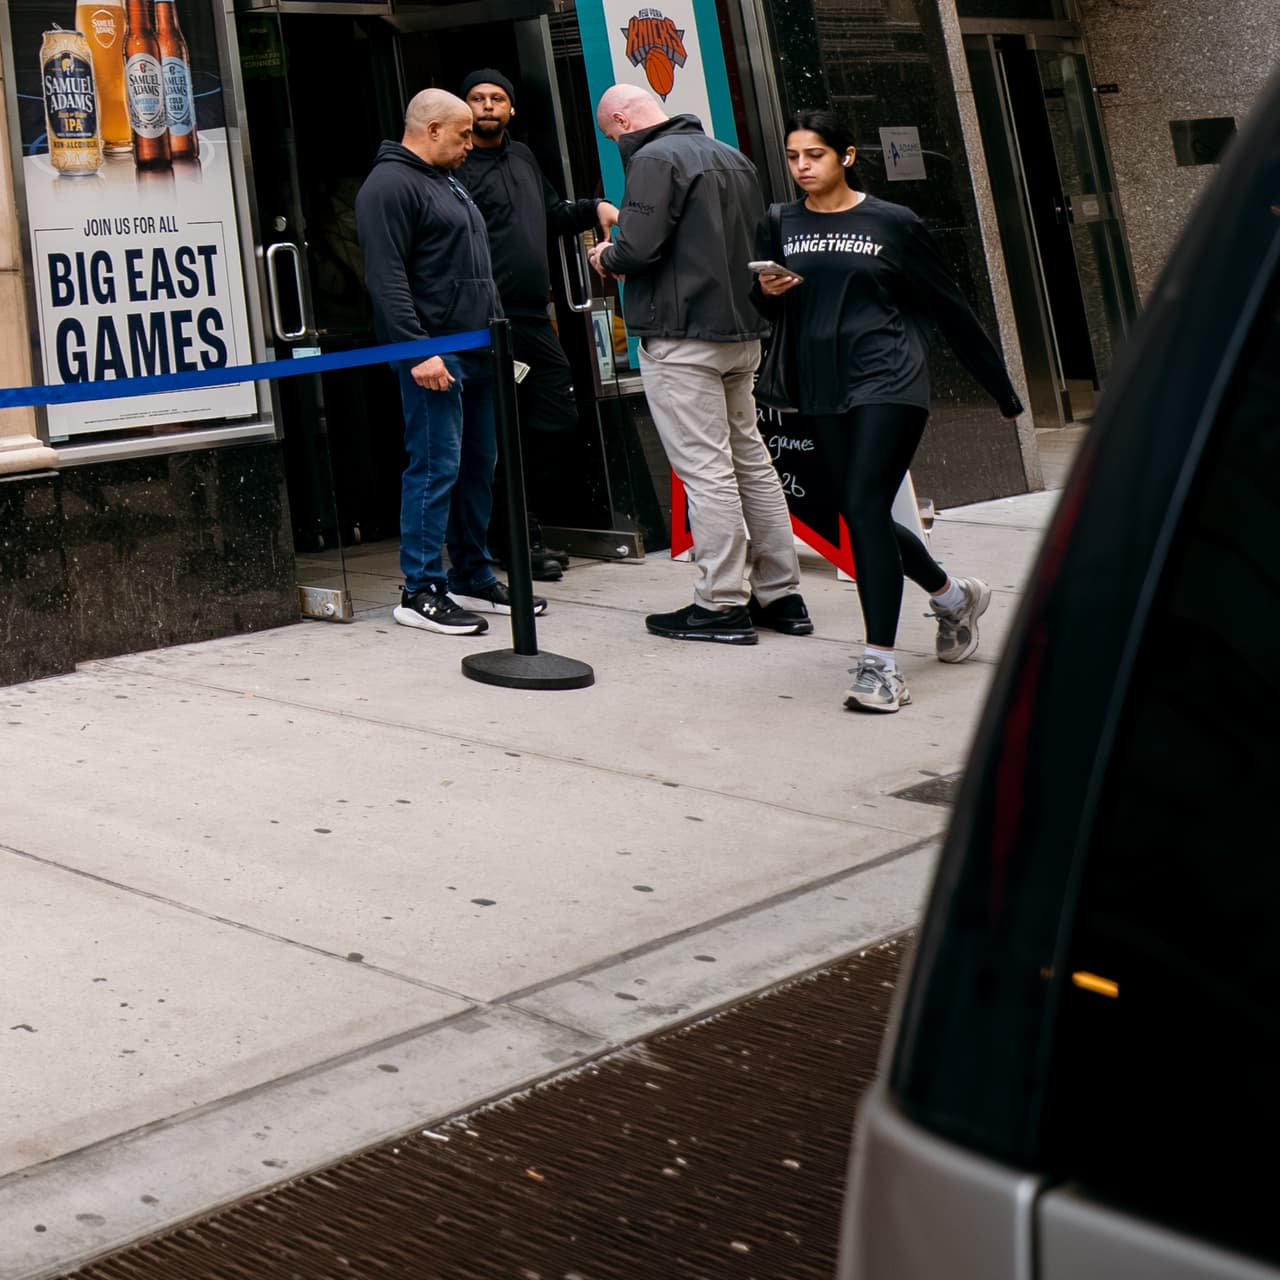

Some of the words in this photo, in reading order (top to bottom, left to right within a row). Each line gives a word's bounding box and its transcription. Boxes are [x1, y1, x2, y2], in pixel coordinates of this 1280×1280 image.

[626, 17, 682, 57] KNICKS
[44, 75, 94, 97] SAMUEL
[129, 73, 161, 87] SAMUEL
[132, 84, 160, 97] ADAMS
[50, 93, 93, 113] ADAMS
[64, 118, 84, 132] IPA
[83, 217, 112, 237] JOIN
[115, 217, 131, 235] US
[134, 216, 156, 234] FOR
[159, 215, 179, 233] ALL
[827, 233, 871, 241] MEMBER
[783, 239, 883, 257] ORANGETHEORY
[48, 250, 116, 309] BIG
[125, 245, 217, 302] EAST
[56, 307, 228, 384] GAMES
[768, 434, 815, 461] games
